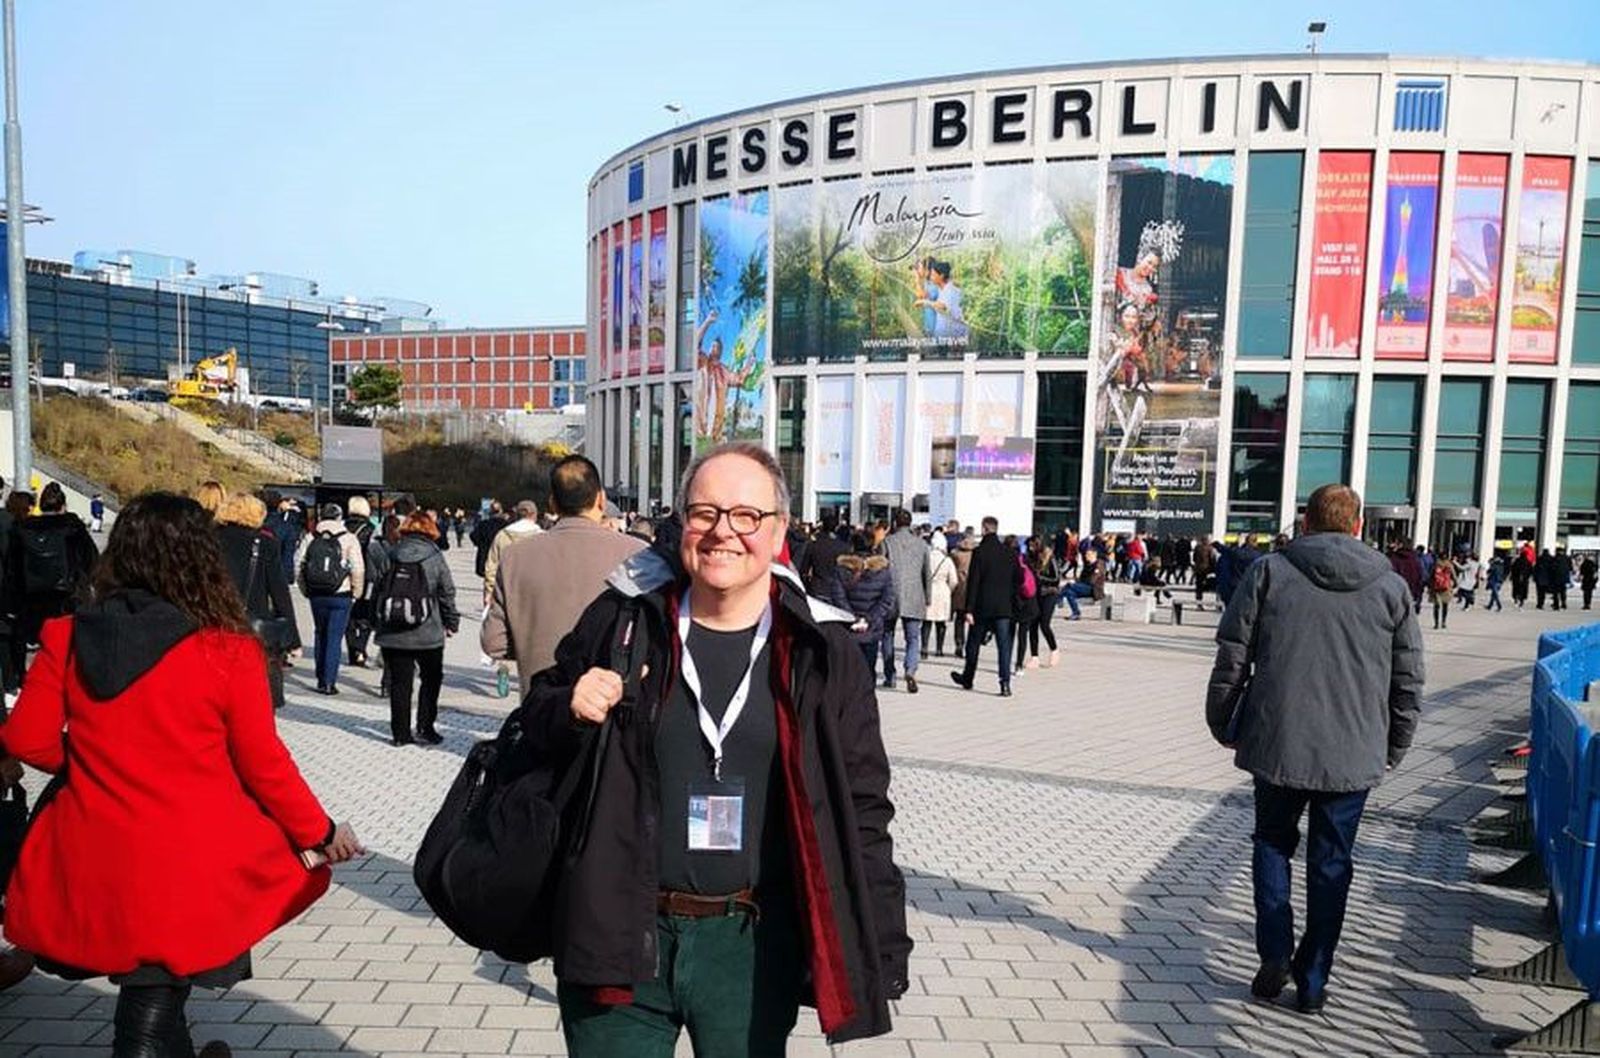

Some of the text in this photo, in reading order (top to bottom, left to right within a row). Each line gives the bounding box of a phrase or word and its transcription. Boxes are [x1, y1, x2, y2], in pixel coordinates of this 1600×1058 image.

[673, 79, 1304, 190] MESSE BERLIN
[847, 191, 983, 263] Malaysia
[1103, 508, 1205, 521] www.malaysia.travel
